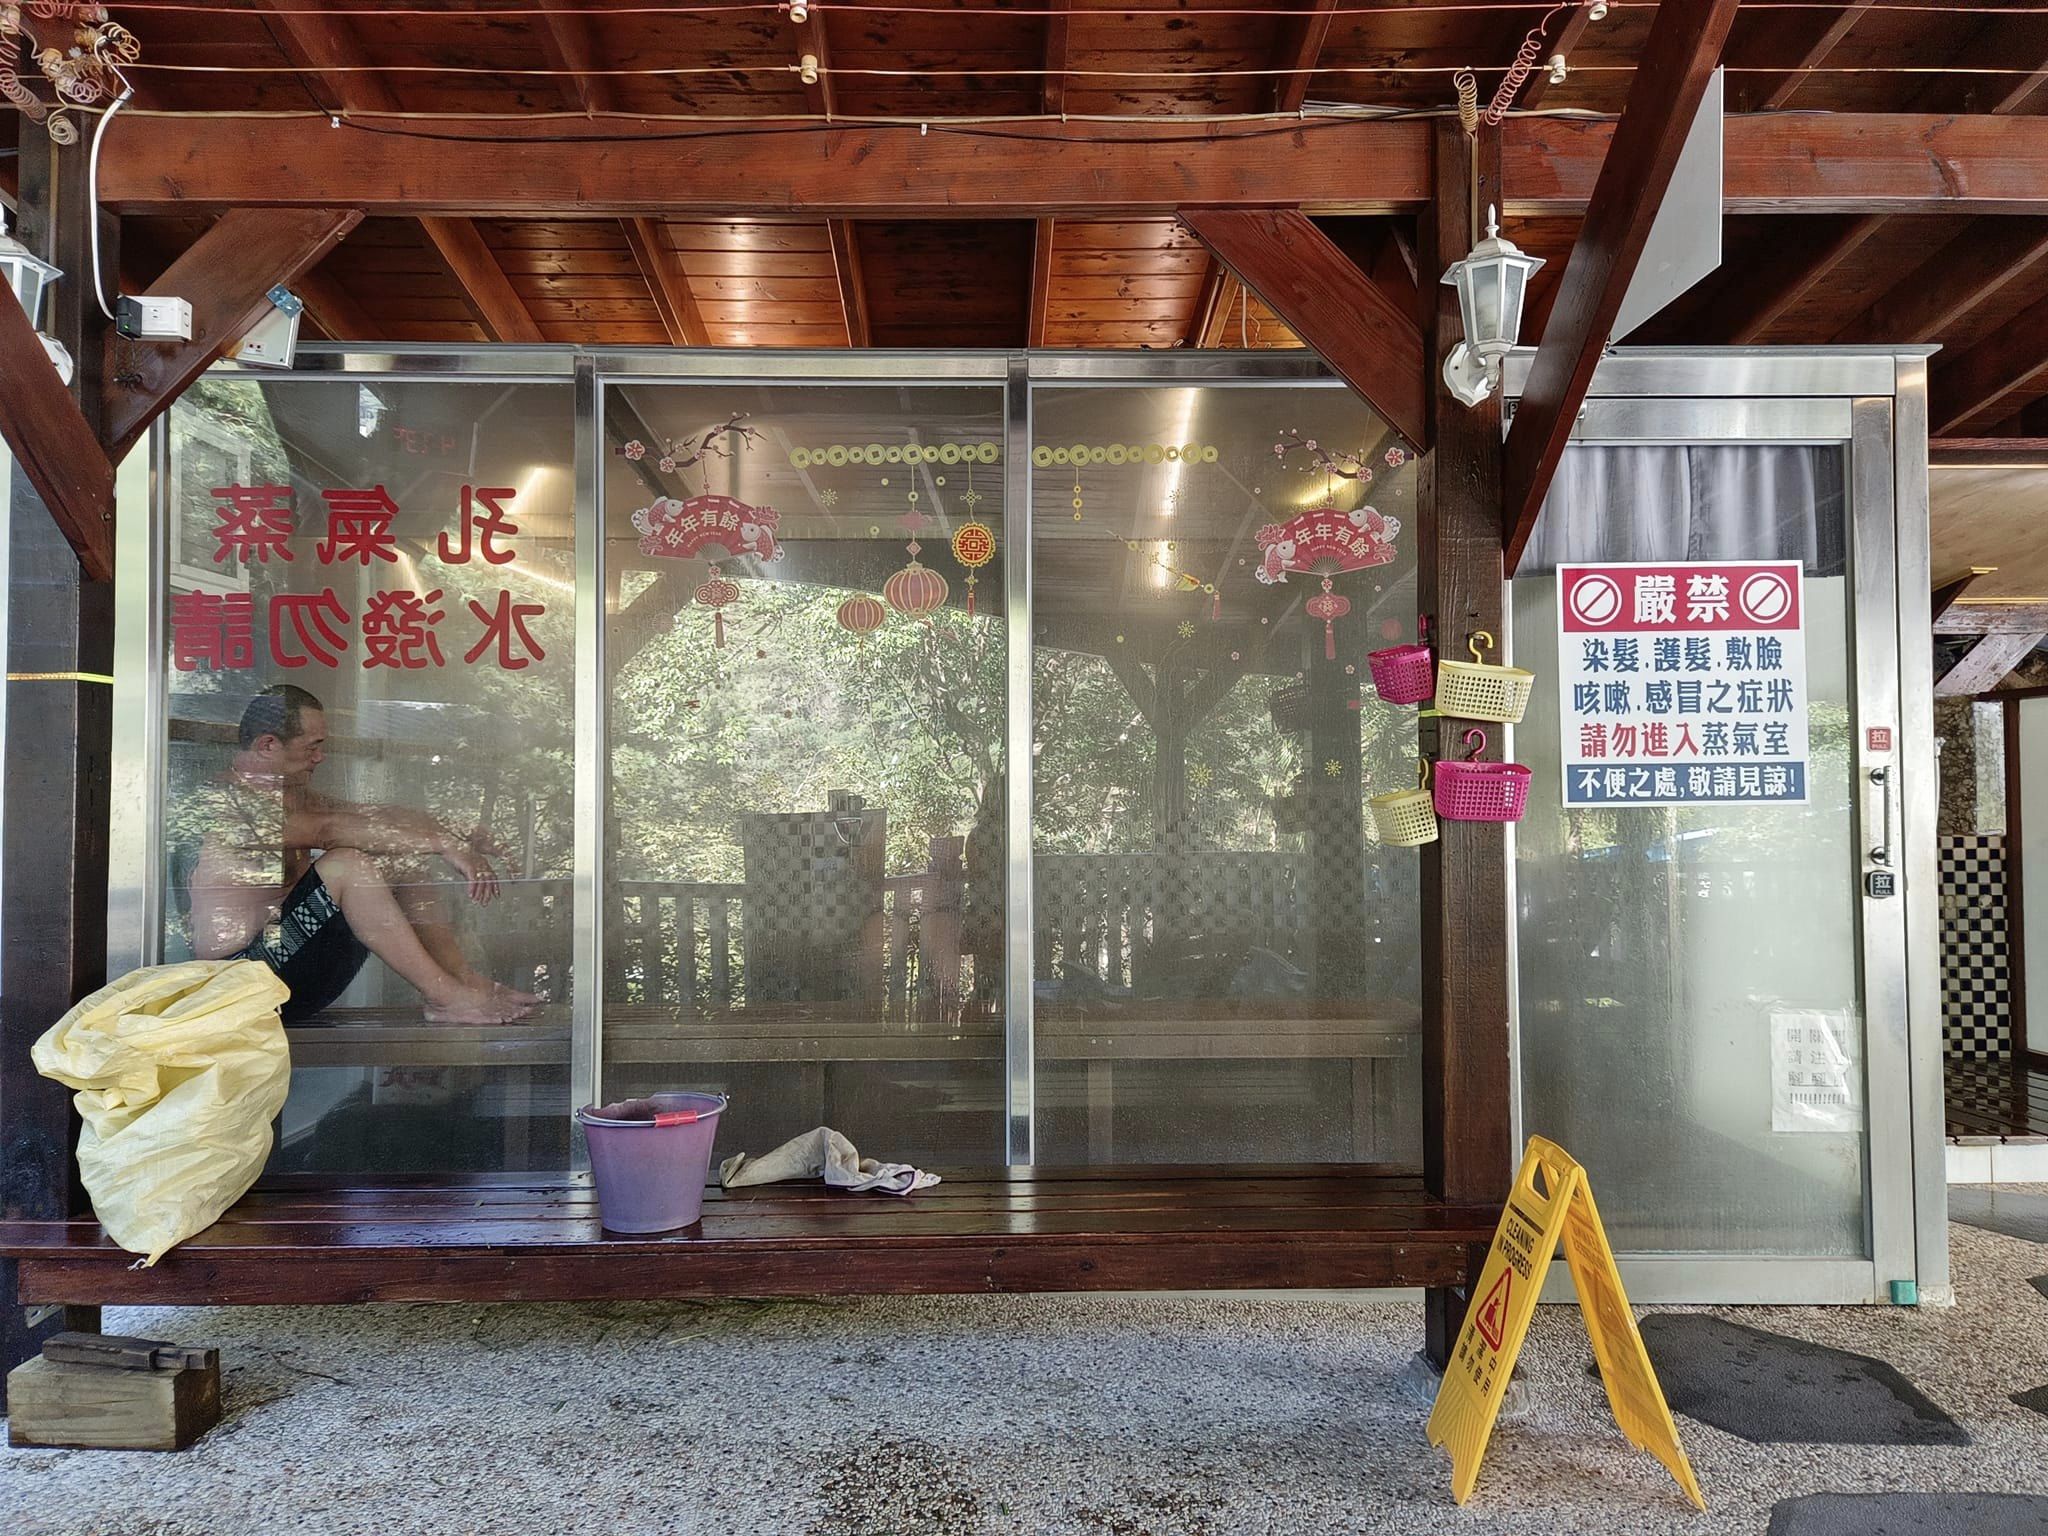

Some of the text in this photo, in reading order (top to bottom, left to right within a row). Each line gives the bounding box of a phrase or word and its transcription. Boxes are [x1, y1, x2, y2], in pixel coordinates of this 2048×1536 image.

[665, 509, 741, 548] 年年有餘
[1296, 523, 1370, 559] 年年有餘
[1633, 574, 1730, 624] 嚴禁
[1580, 721, 1789, 758] 請勿進入蒸氣室
[1872, 730, 1887, 743] 拉
[1875, 876, 1891, 889] 拉
[1506, 1217, 1535, 1254] CLEANING
[1496, 1234, 1505, 1255] IN
[1503, 1239, 1533, 1280] PROGRESS
